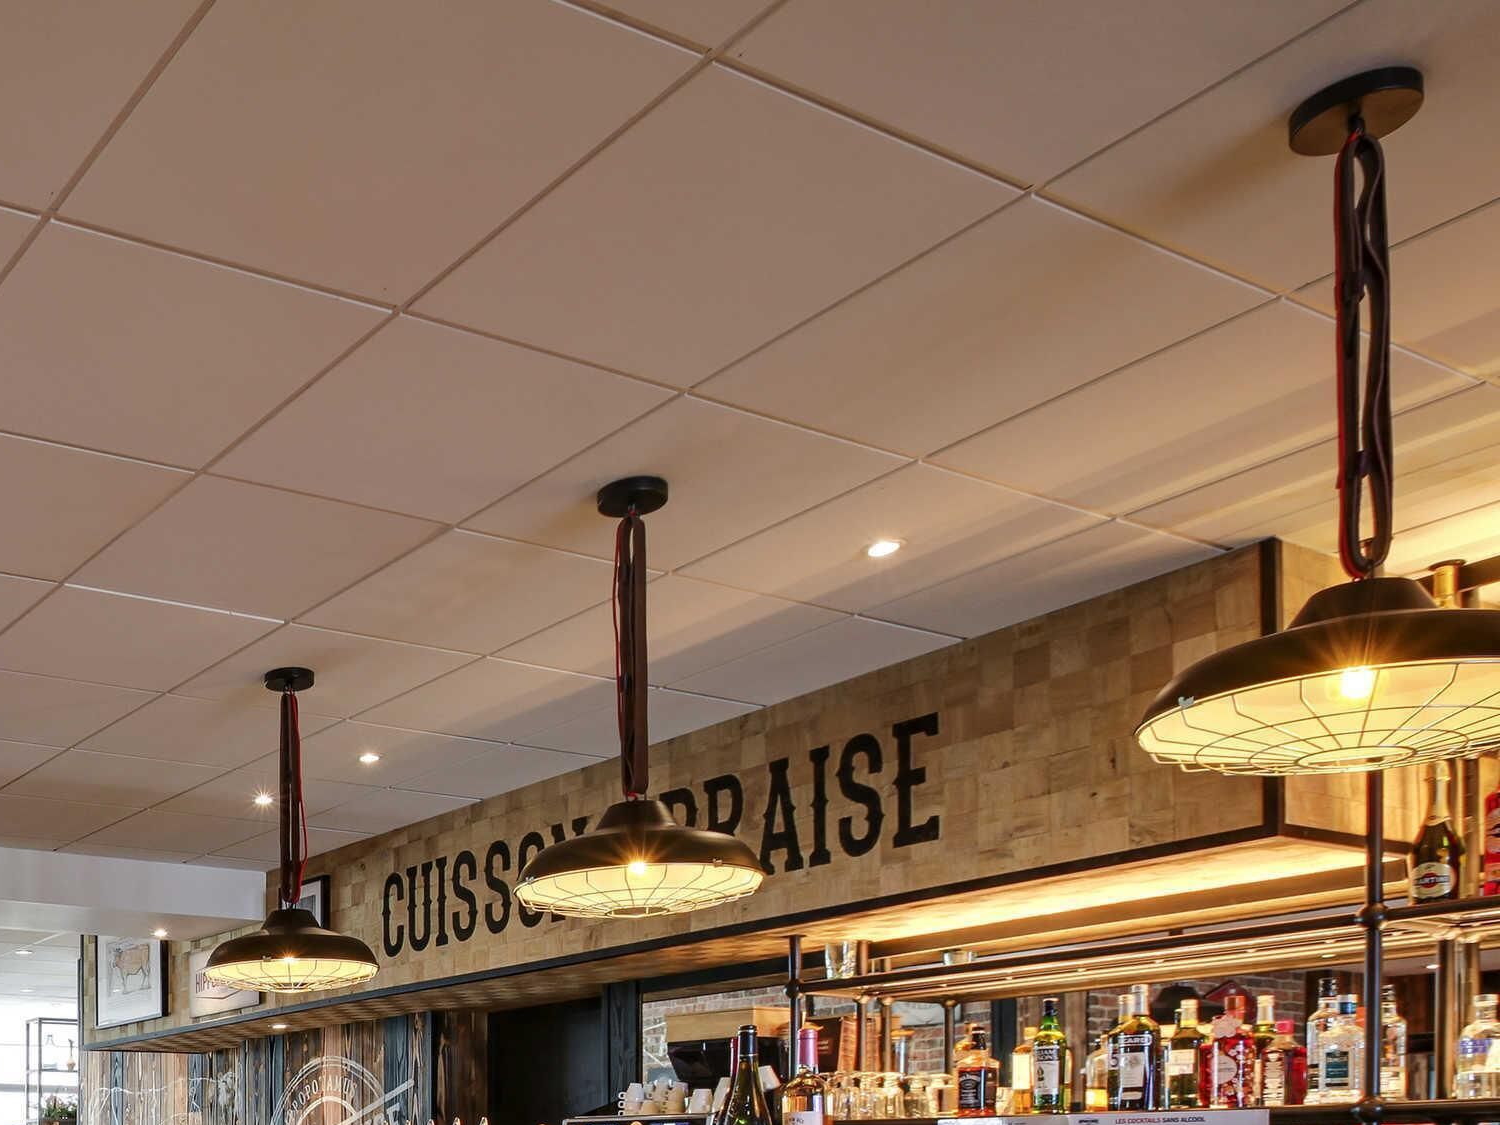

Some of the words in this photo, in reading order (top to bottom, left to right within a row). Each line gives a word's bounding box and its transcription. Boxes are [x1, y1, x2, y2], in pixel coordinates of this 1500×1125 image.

[382, 815, 592, 958] CUISSO
[1127, 1117, 1161, 1125] COCKTAILS
[1180, 1115, 1206, 1123] ALCOOL
